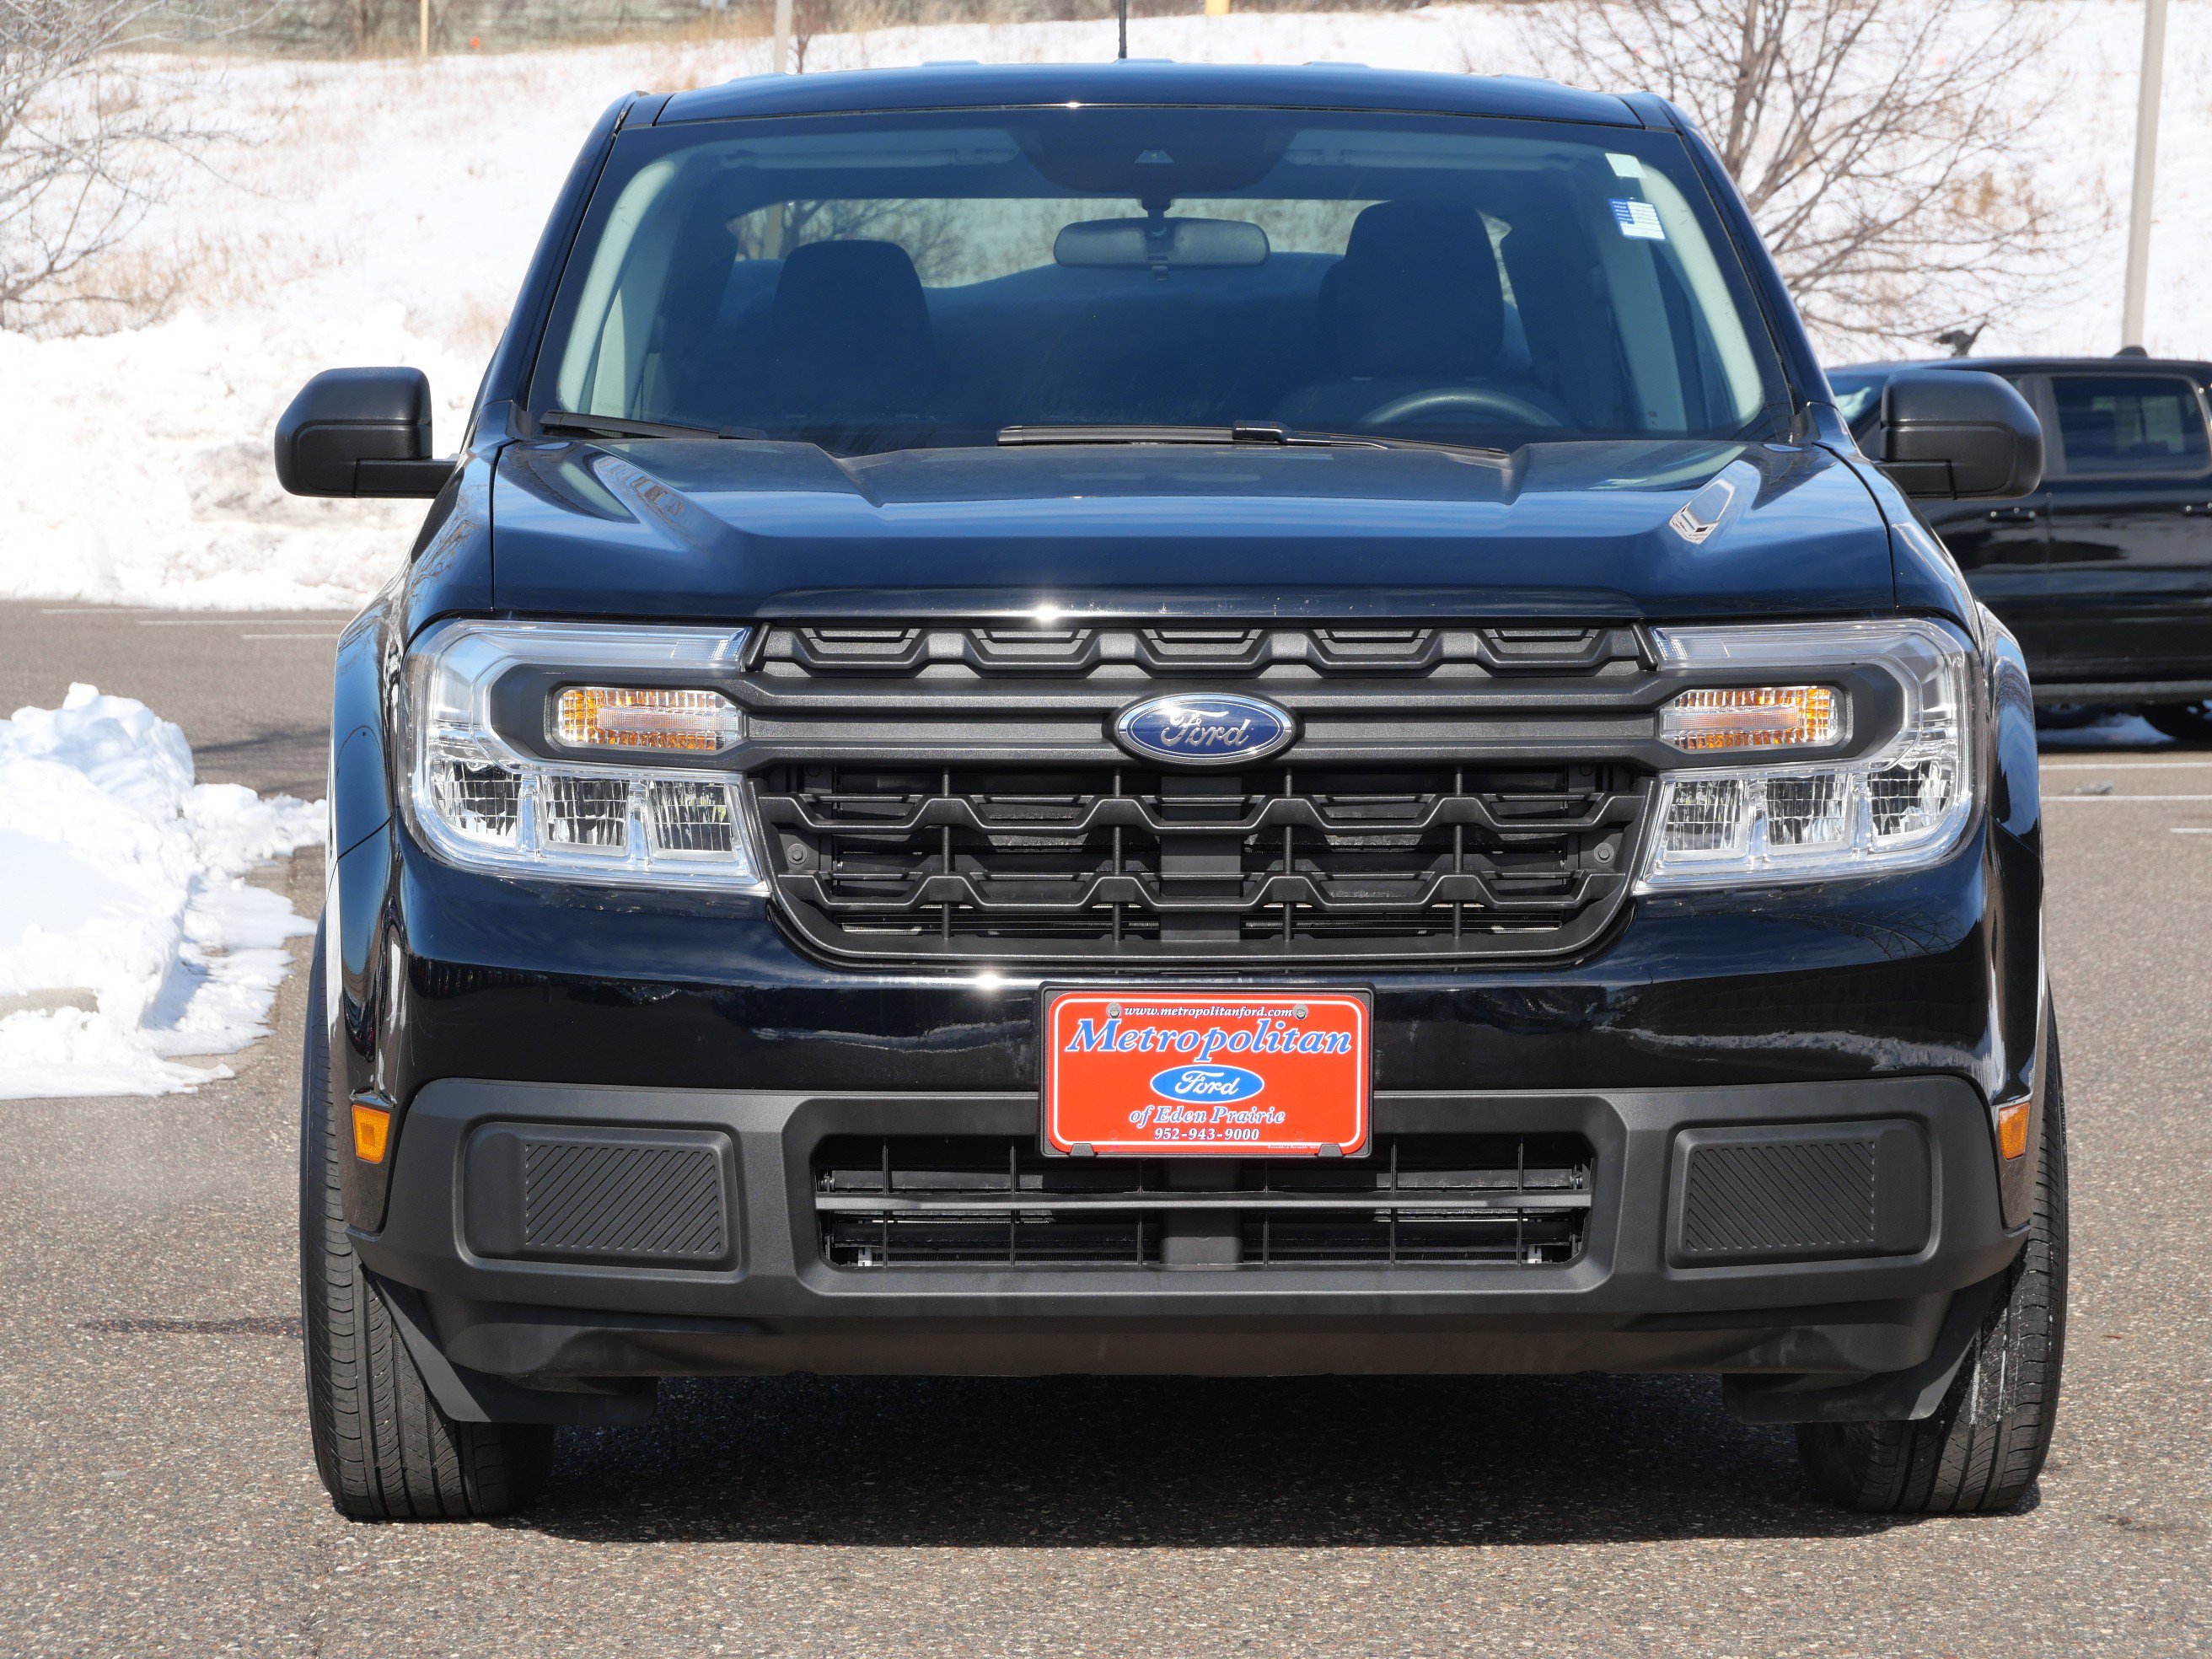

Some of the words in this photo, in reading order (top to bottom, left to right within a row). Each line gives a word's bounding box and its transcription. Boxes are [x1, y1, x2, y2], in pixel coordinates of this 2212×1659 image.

[1160, 707, 1249, 747] Ford
[1125, 1006, 1294, 1019] www.metropolitanford.com
[1064, 1017, 1352, 1063] Metropolitan
[1174, 1070, 1241, 1095] Ford
[1129, 1104, 1155, 1129] of
[1153, 1106, 1208, 1124] Eden
[1211, 1106, 1286, 1124] Prairie
[1154, 1127, 1261, 1141] 952-943-9000
